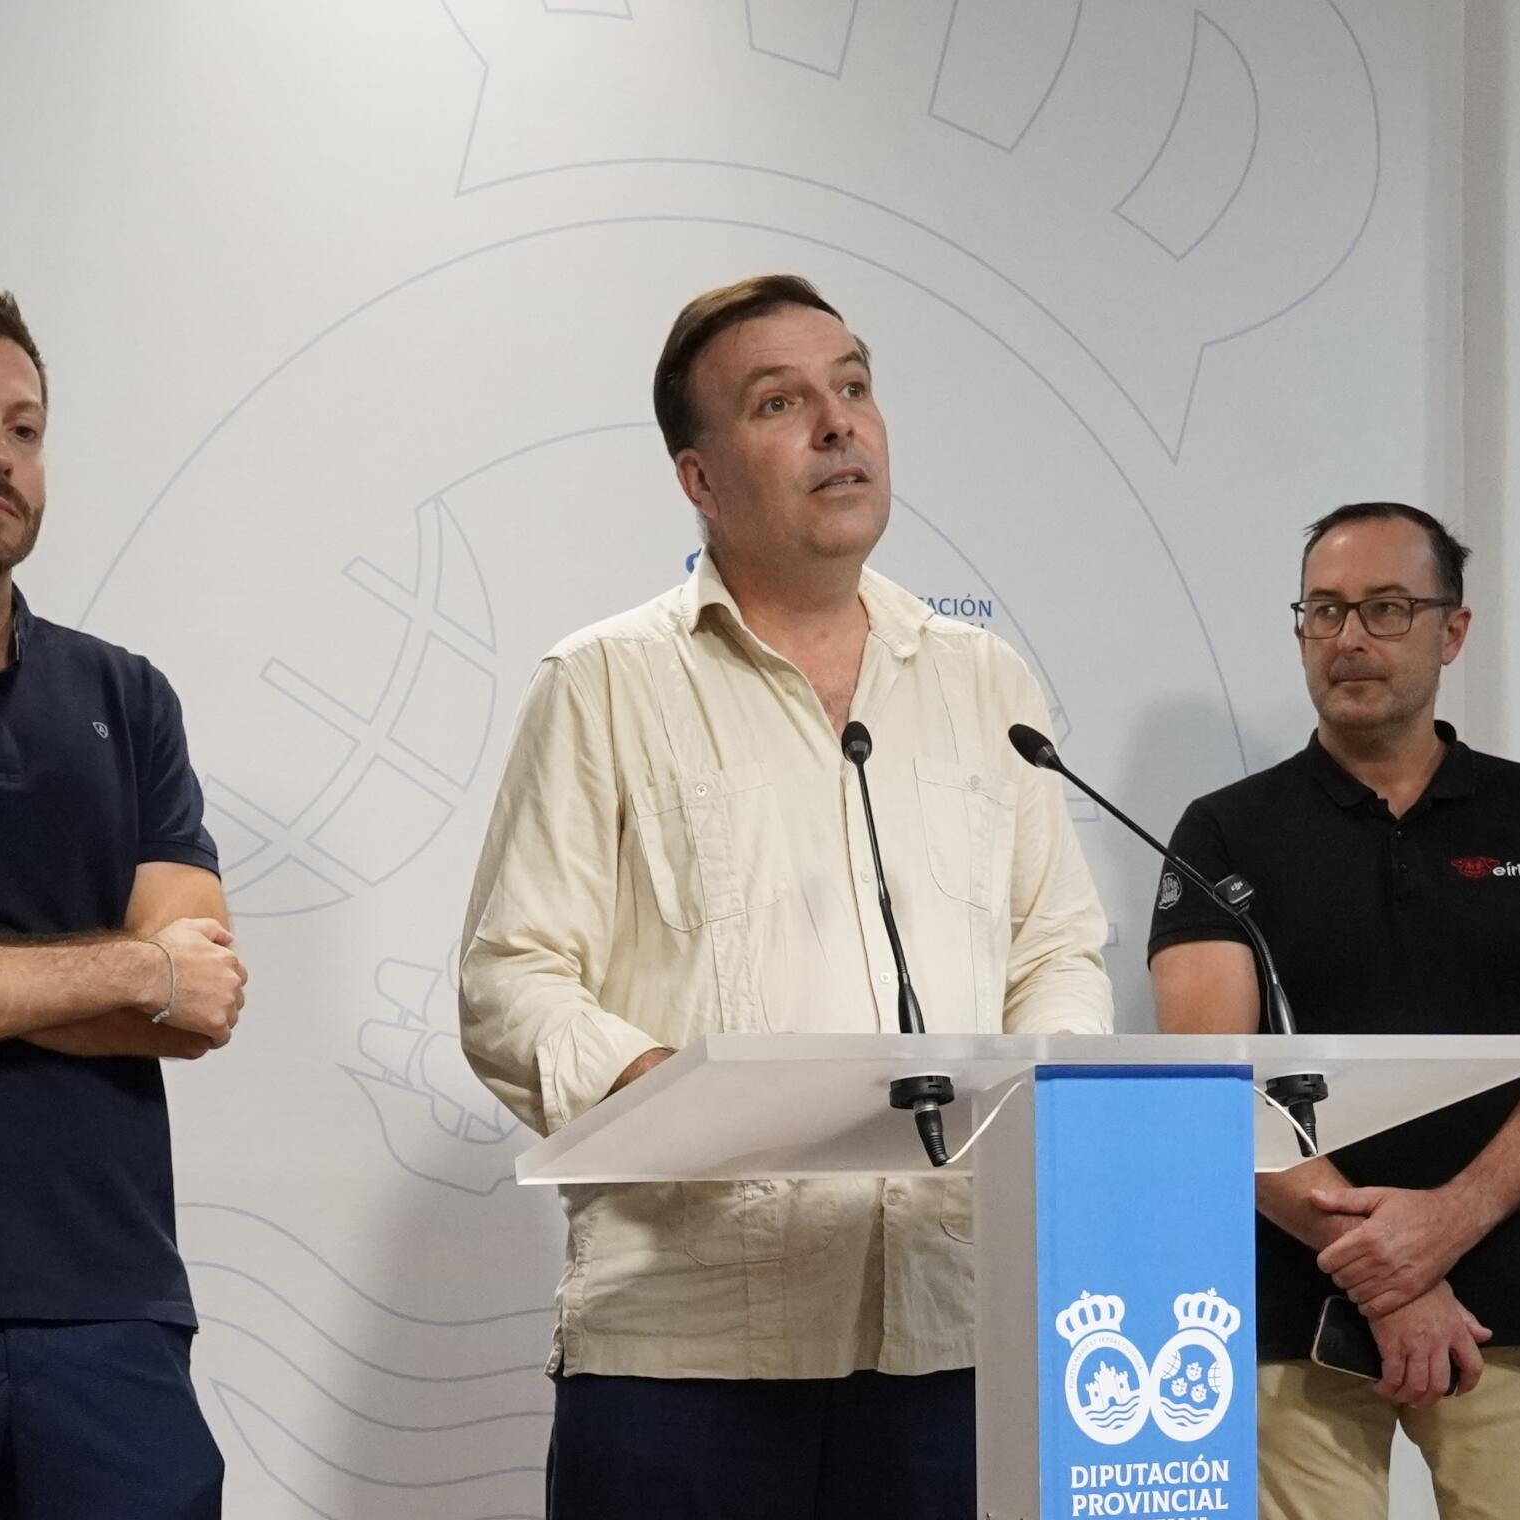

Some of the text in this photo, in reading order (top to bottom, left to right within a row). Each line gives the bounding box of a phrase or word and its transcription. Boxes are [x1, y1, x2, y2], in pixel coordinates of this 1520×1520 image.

[917, 593, 992, 617] ACIÓN
[1070, 1453, 1229, 1489] DIPUTACIÓN
[1072, 1487, 1229, 1517] PROVINCIAL
